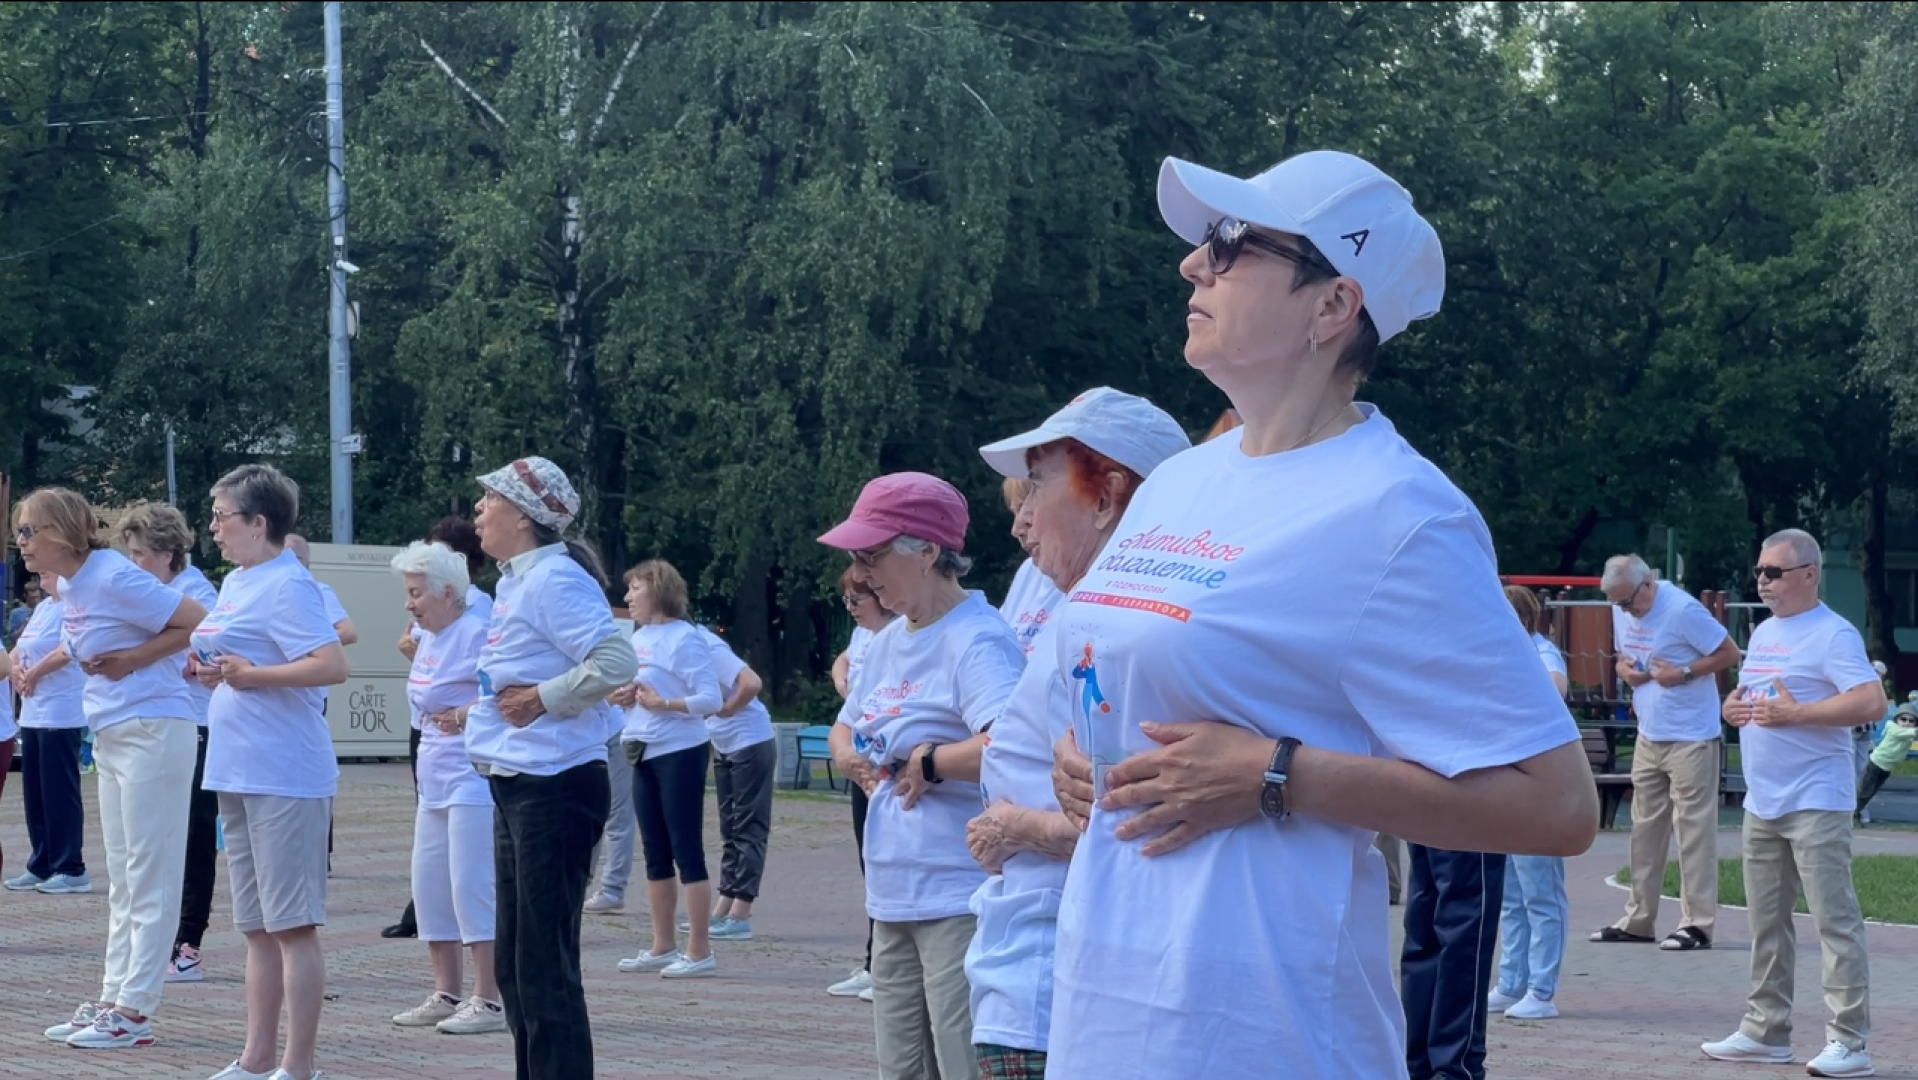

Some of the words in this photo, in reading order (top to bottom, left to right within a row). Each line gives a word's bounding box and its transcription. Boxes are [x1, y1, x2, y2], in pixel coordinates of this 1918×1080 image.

[1340, 228, 1370, 257] A
[349, 690, 387, 710] CARTE
[350, 708, 393, 733] D'OR
